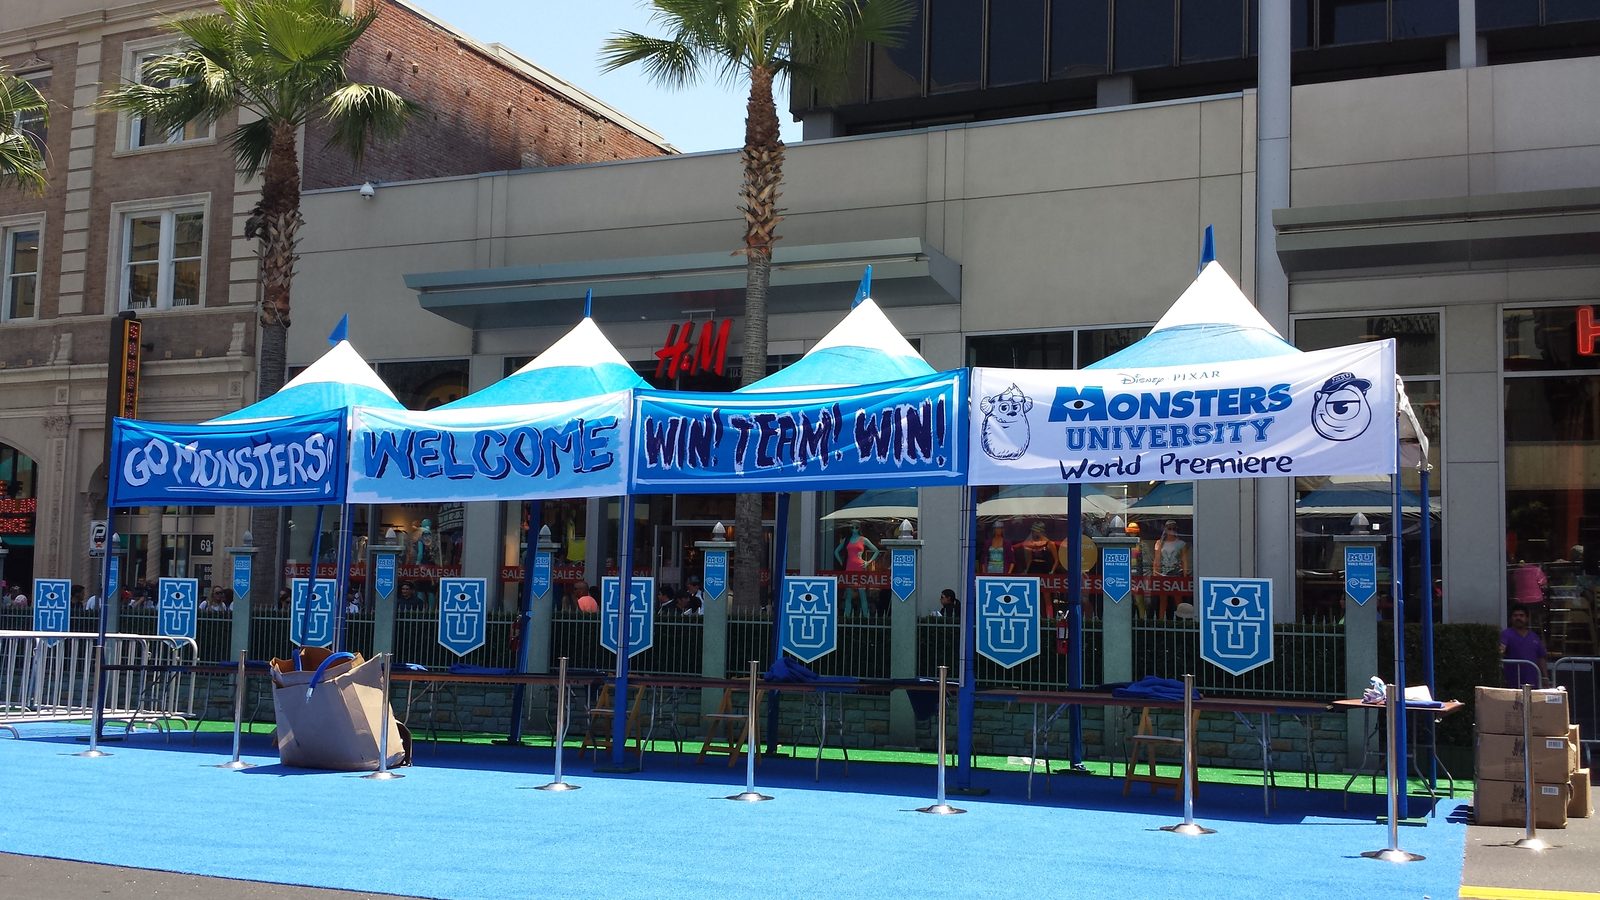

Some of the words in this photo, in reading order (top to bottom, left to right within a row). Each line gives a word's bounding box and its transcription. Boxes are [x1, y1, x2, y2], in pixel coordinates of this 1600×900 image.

[655, 317, 733, 379] H&M
[1173, 371, 1220, 381] PIXAR
[1048, 384, 1293, 422] MONSTERS
[363, 416, 618, 480] WELCOME
[644, 408, 723, 470] WIN!
[728, 403, 843, 476] TEAM!
[853, 394, 947, 468] WIN!
[1066, 419, 1274, 451] UNIVERSITY
[124, 437, 168, 487] GO
[174, 433, 335, 494] MONSTERS!
[1059, 455, 1141, 480] World
[1160, 452, 1293, 475] Premiere
[860, 575, 888, 585] SALE
